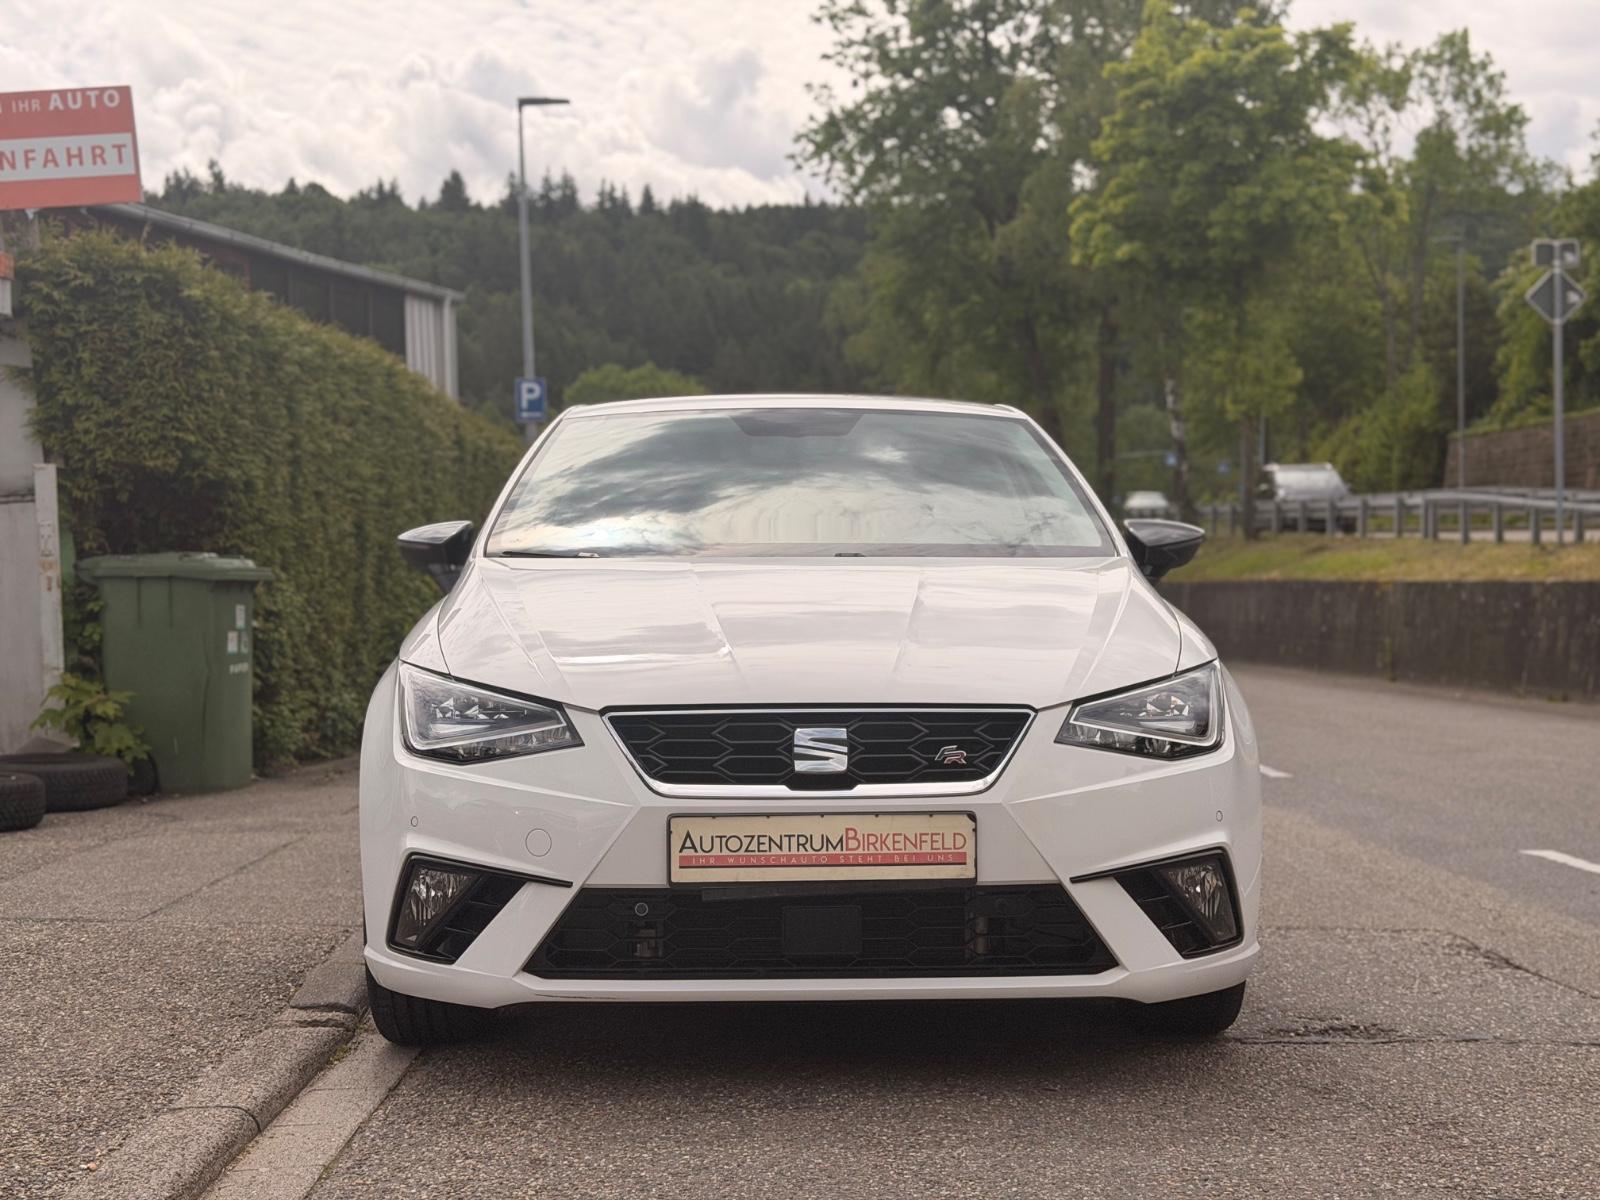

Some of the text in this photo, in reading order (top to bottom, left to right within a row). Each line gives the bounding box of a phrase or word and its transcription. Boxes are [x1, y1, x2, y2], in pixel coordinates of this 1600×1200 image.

[11, 98, 41, 113] IHR
[49, 89, 121, 111] AUTO
[0, 143, 127, 171] NFAHRT
[521, 382, 541, 410] P
[691, 852, 955, 866] IHR WUNSCHAUTO STEHT BEI UNS
